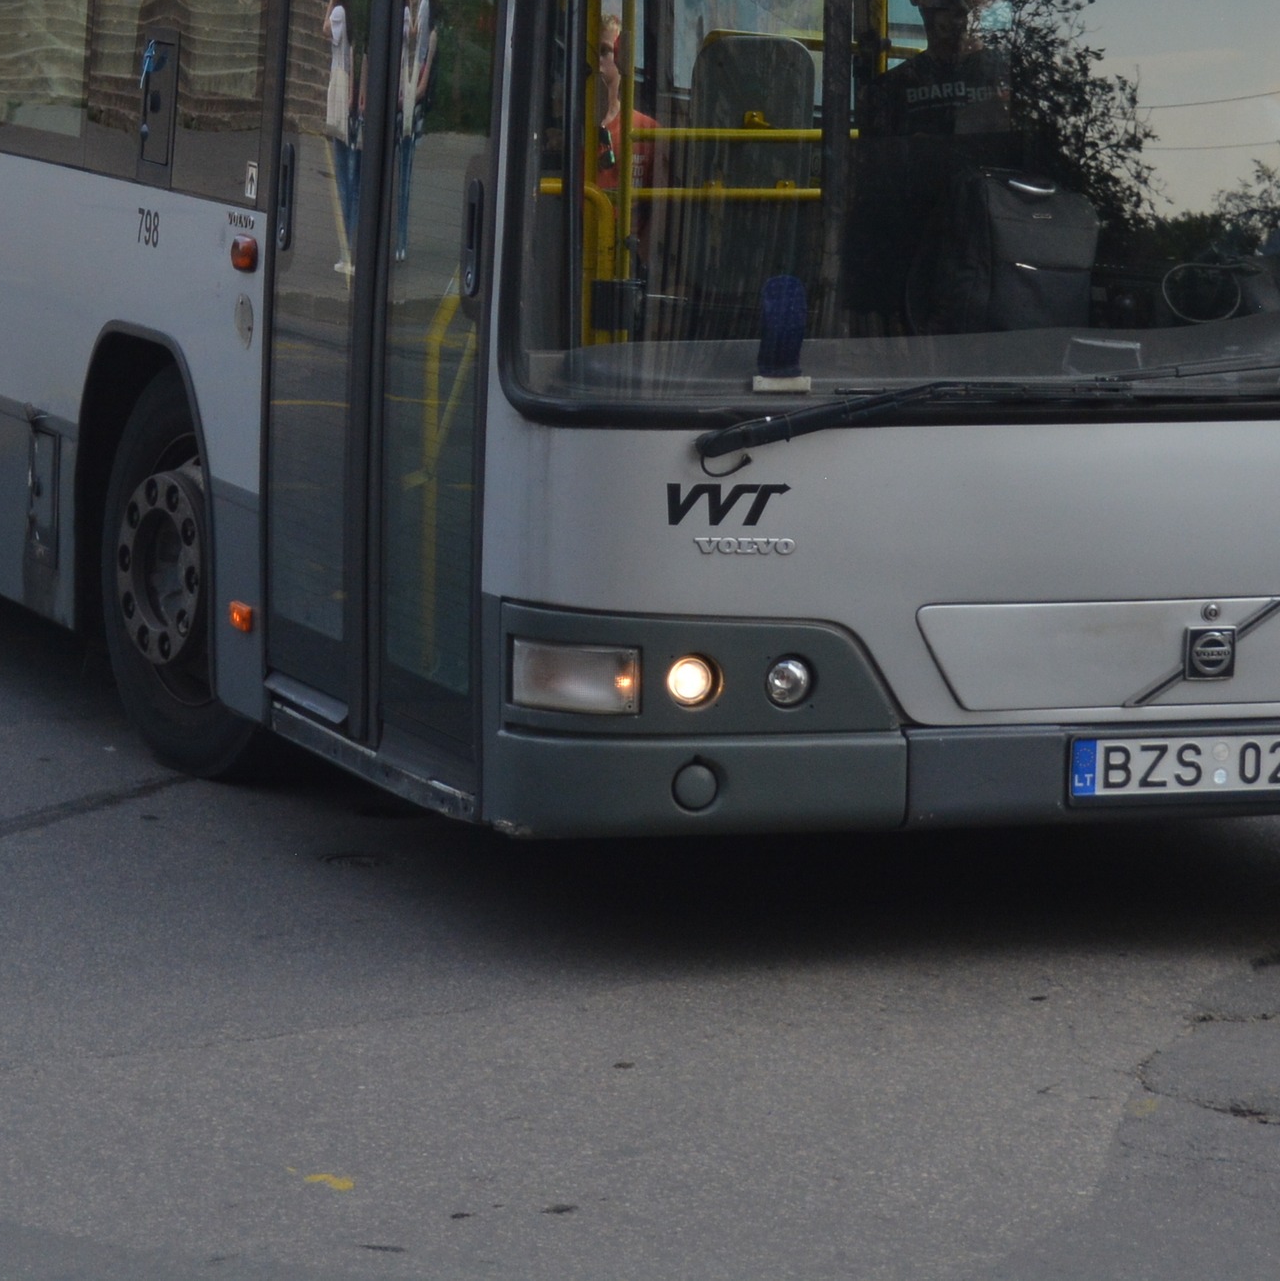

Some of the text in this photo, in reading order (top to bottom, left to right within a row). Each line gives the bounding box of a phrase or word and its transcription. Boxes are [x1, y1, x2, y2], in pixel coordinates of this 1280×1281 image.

[137, 207, 160, 249] 798
[228, 211, 255, 230] VOLVO
[693, 537, 796, 555] VOLVO
[1194, 649, 1231, 658] VOLVO
[1102, 742, 1203, 789] BZS
[1074, 773, 1094, 787] LT
